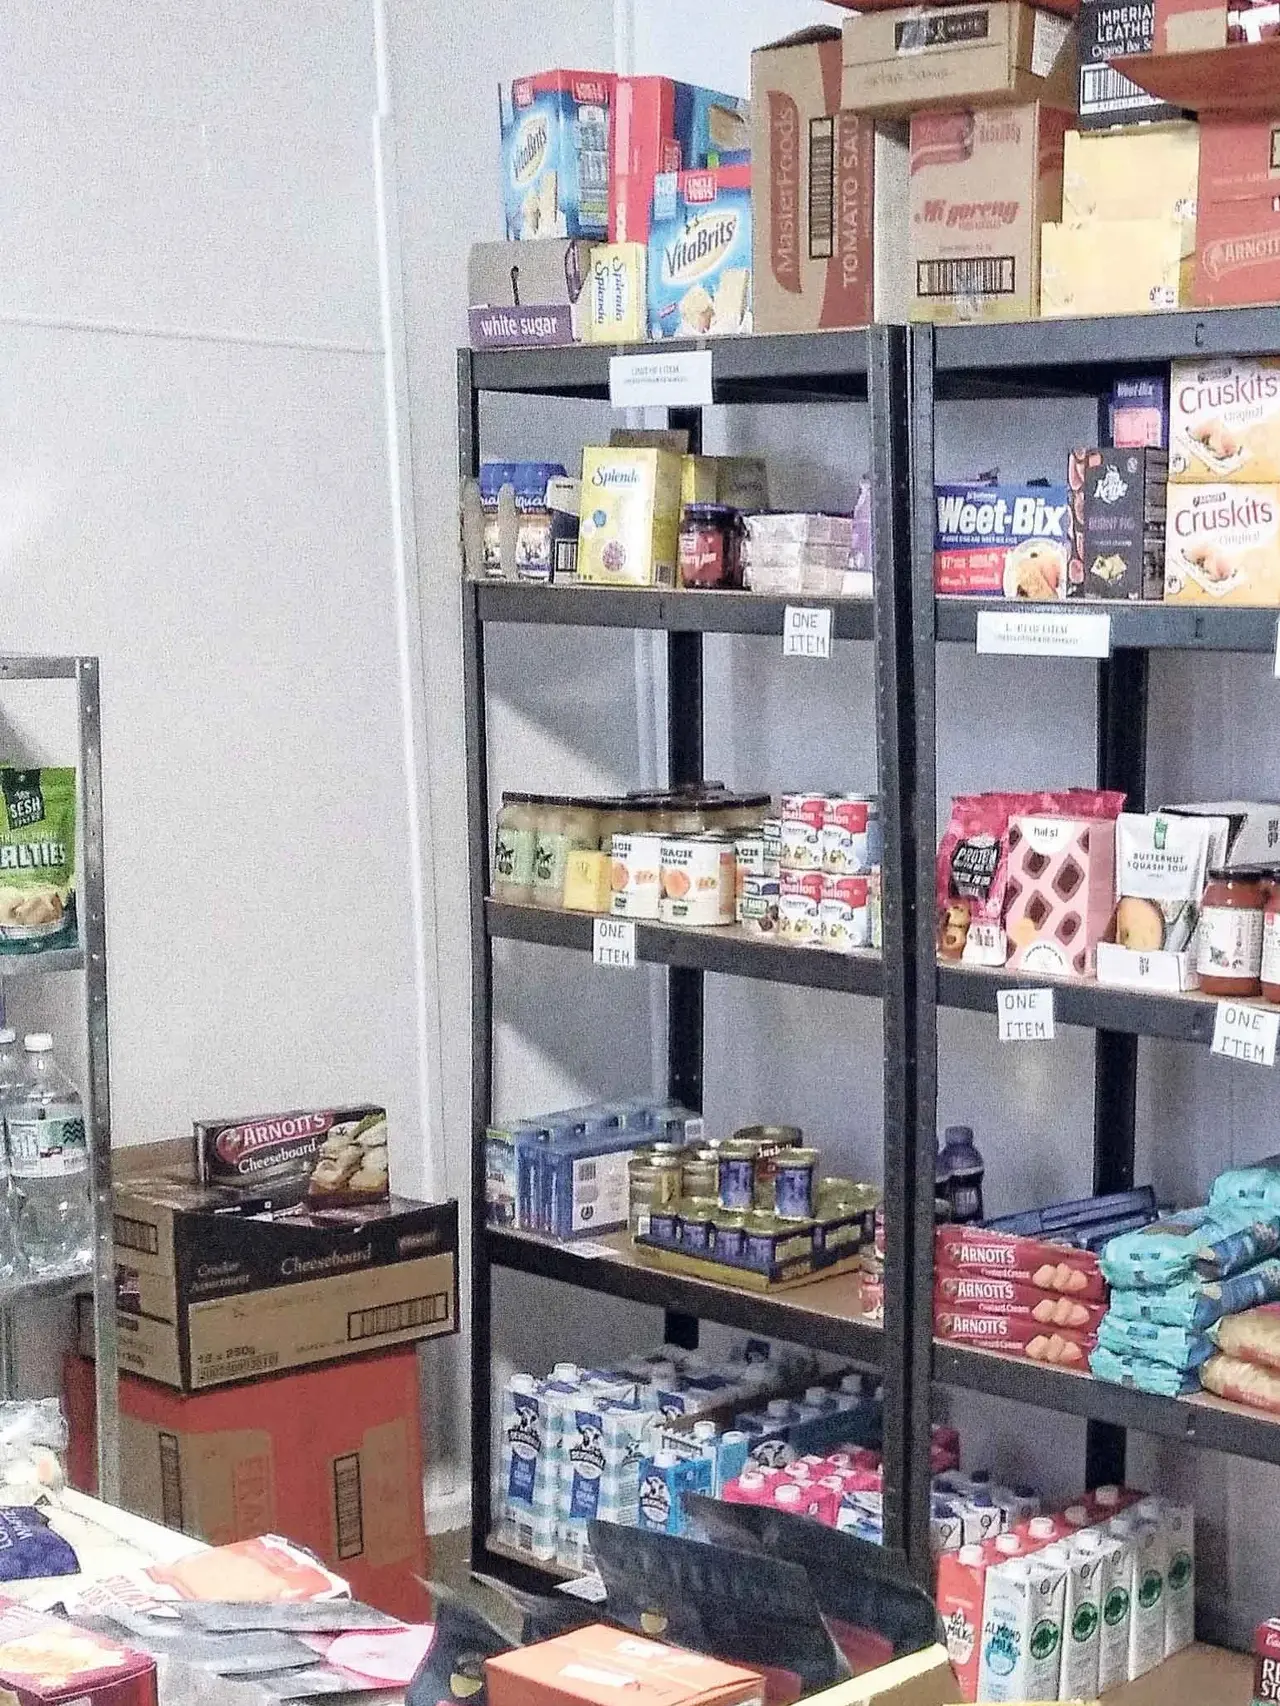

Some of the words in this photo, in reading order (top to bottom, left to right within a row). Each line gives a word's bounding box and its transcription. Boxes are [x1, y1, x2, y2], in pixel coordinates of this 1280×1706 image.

[842, 178, 861, 289] TOMATO
[665, 219, 736, 278] VitaBrits
[480, 317, 518, 338] white
[519, 313, 559, 337] sugar
[1178, 372, 1279, 415] Cruskits
[937, 495, 1069, 537] Weet-Bix
[1174, 497, 1274, 538] Cruskits
[791, 612, 821, 629] ONE
[788, 634, 827, 655] ITEM
[10, 795, 41, 820] SESH
[1126, 861, 1165, 873] SQUASH
[1132, 852, 1185, 864] BUTTERNUT
[599, 924, 625, 939] ONE
[598, 947, 630, 964] ITEM
[1003, 992, 1038, 1010] ONE
[1005, 1021, 1046, 1038] ITEM
[1223, 1007, 1265, 1031] ONE
[1220, 1034, 1266, 1063] ITEM
[241, 1112, 326, 1148] ARNOTT'S
[237, 1138, 319, 1175] Cheeseboard
[280, 1242, 374, 1276] Cheeseboard
